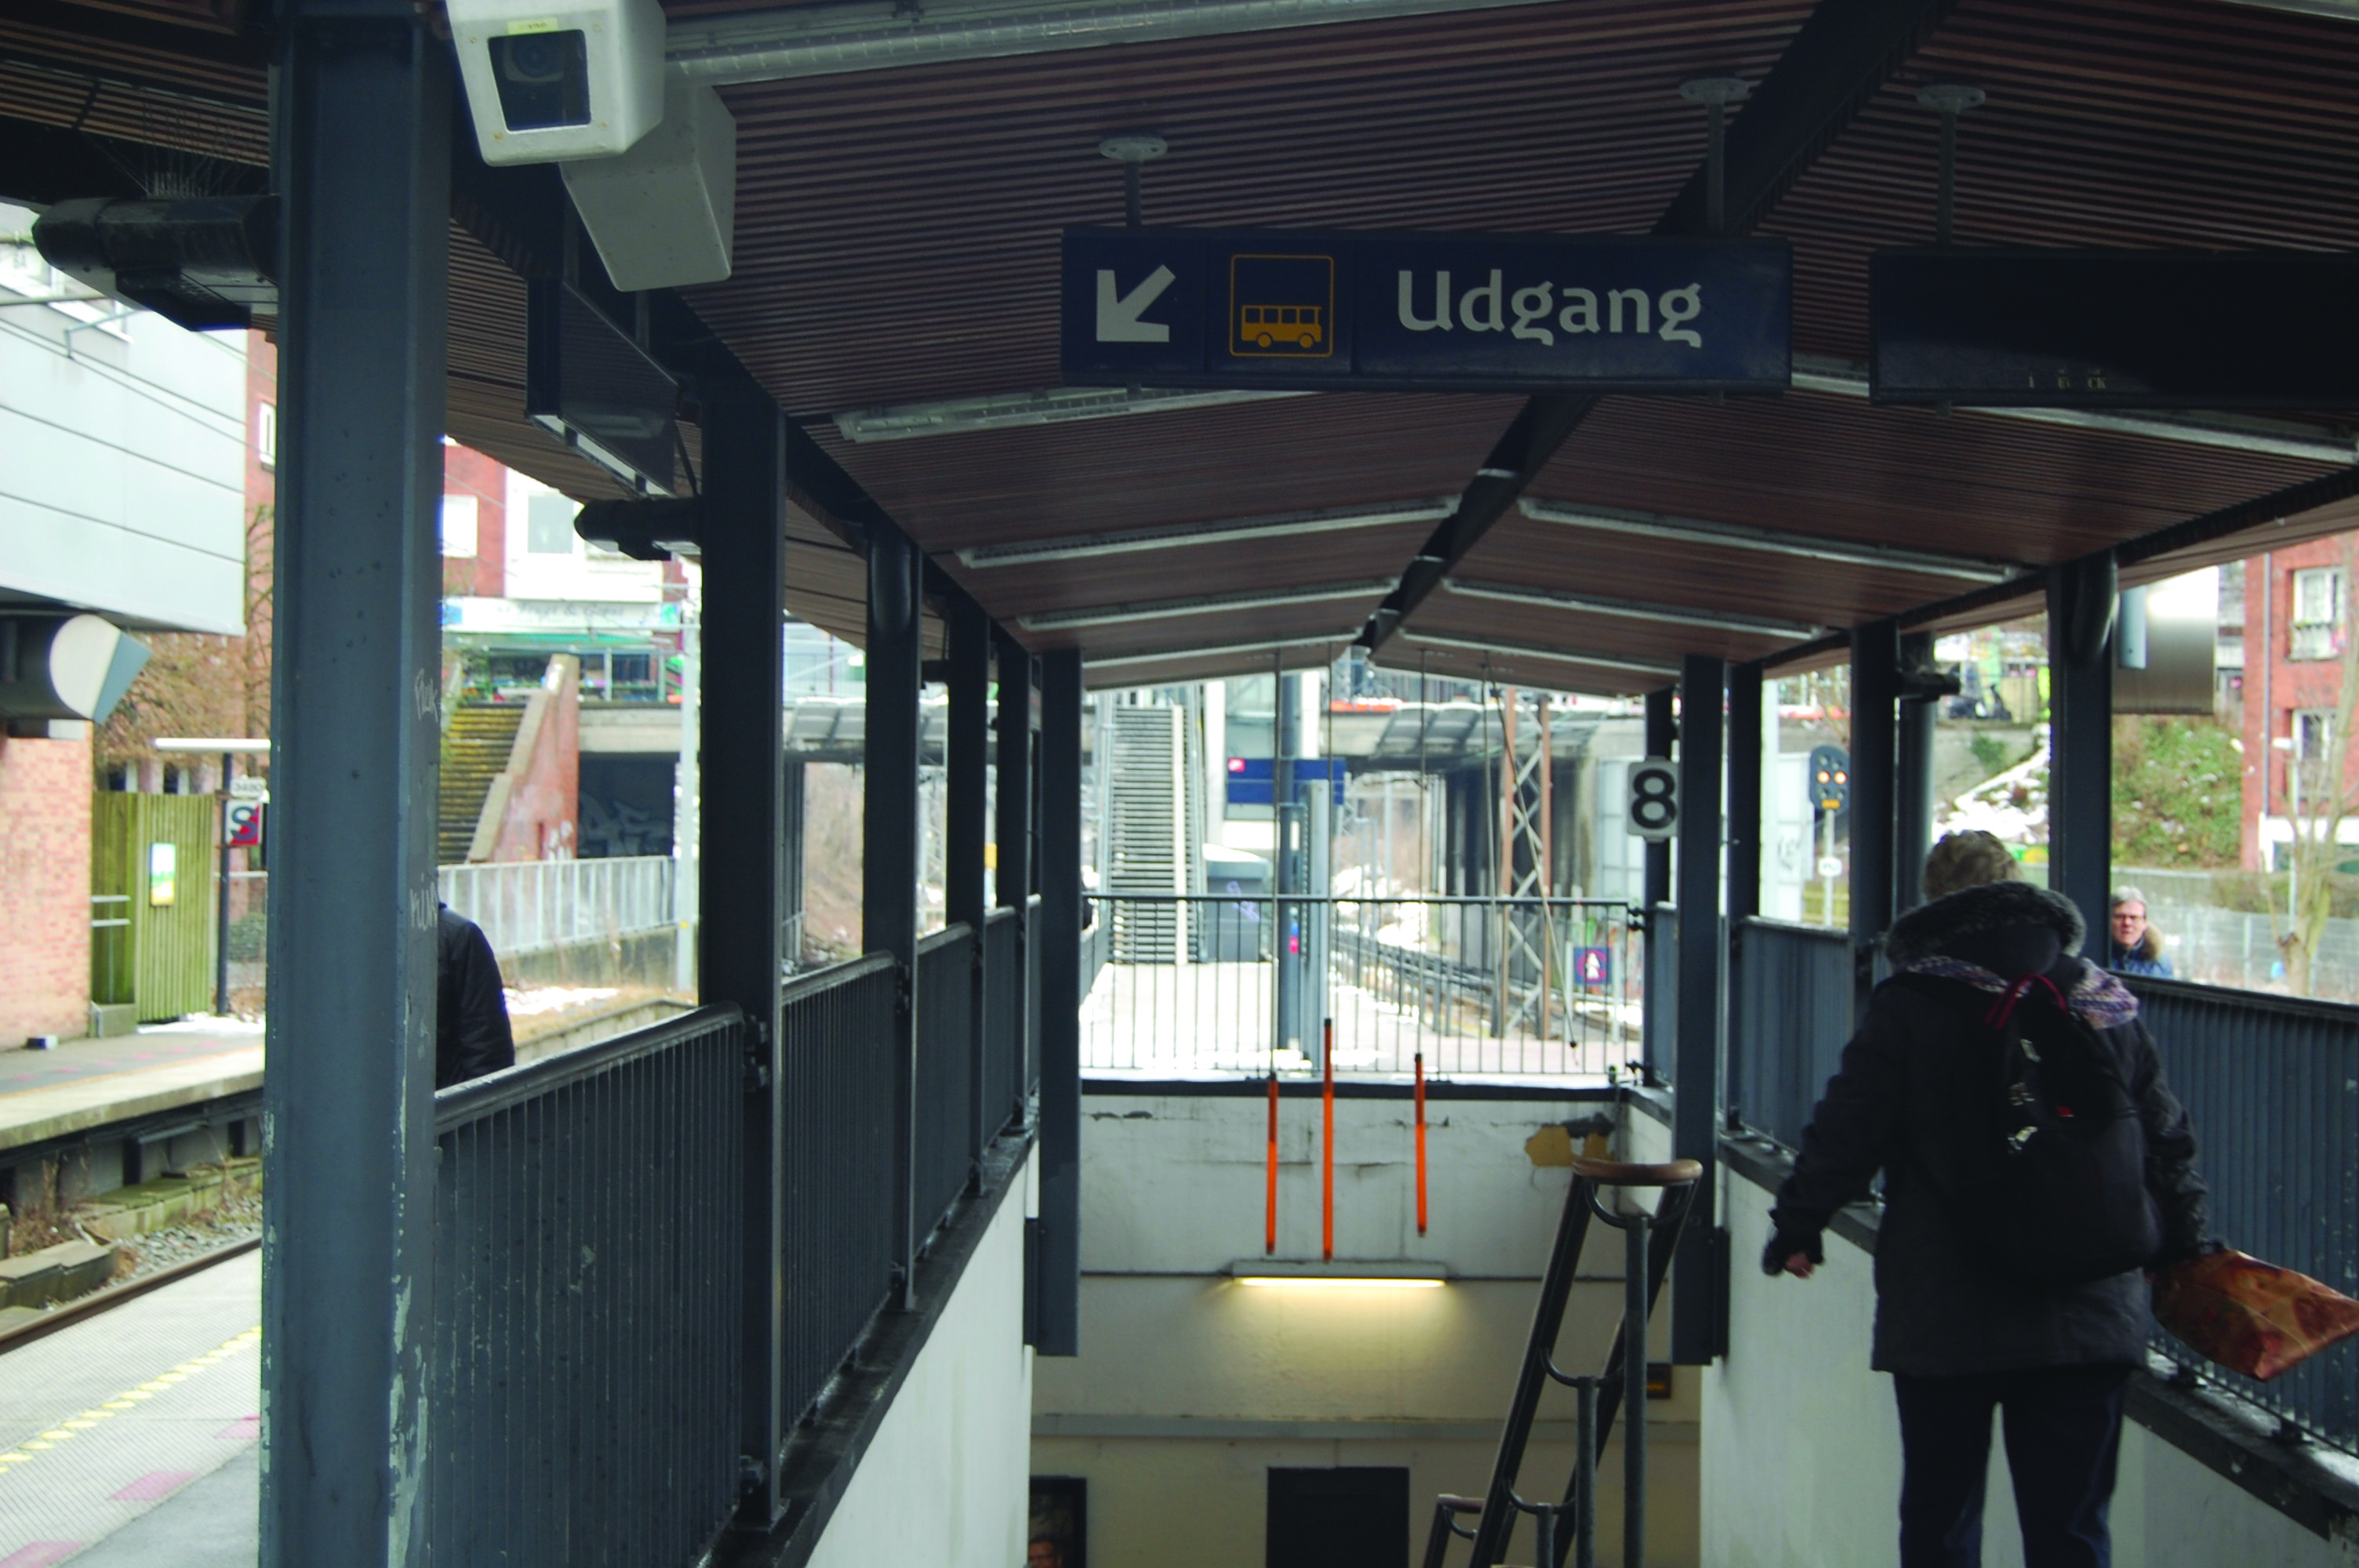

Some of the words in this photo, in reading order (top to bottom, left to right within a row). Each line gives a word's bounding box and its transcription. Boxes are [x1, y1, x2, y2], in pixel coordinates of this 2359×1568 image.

[1398, 269, 1702, 348] Udgang
[230, 806, 258, 841] S
[1632, 768, 1677, 829] 8
